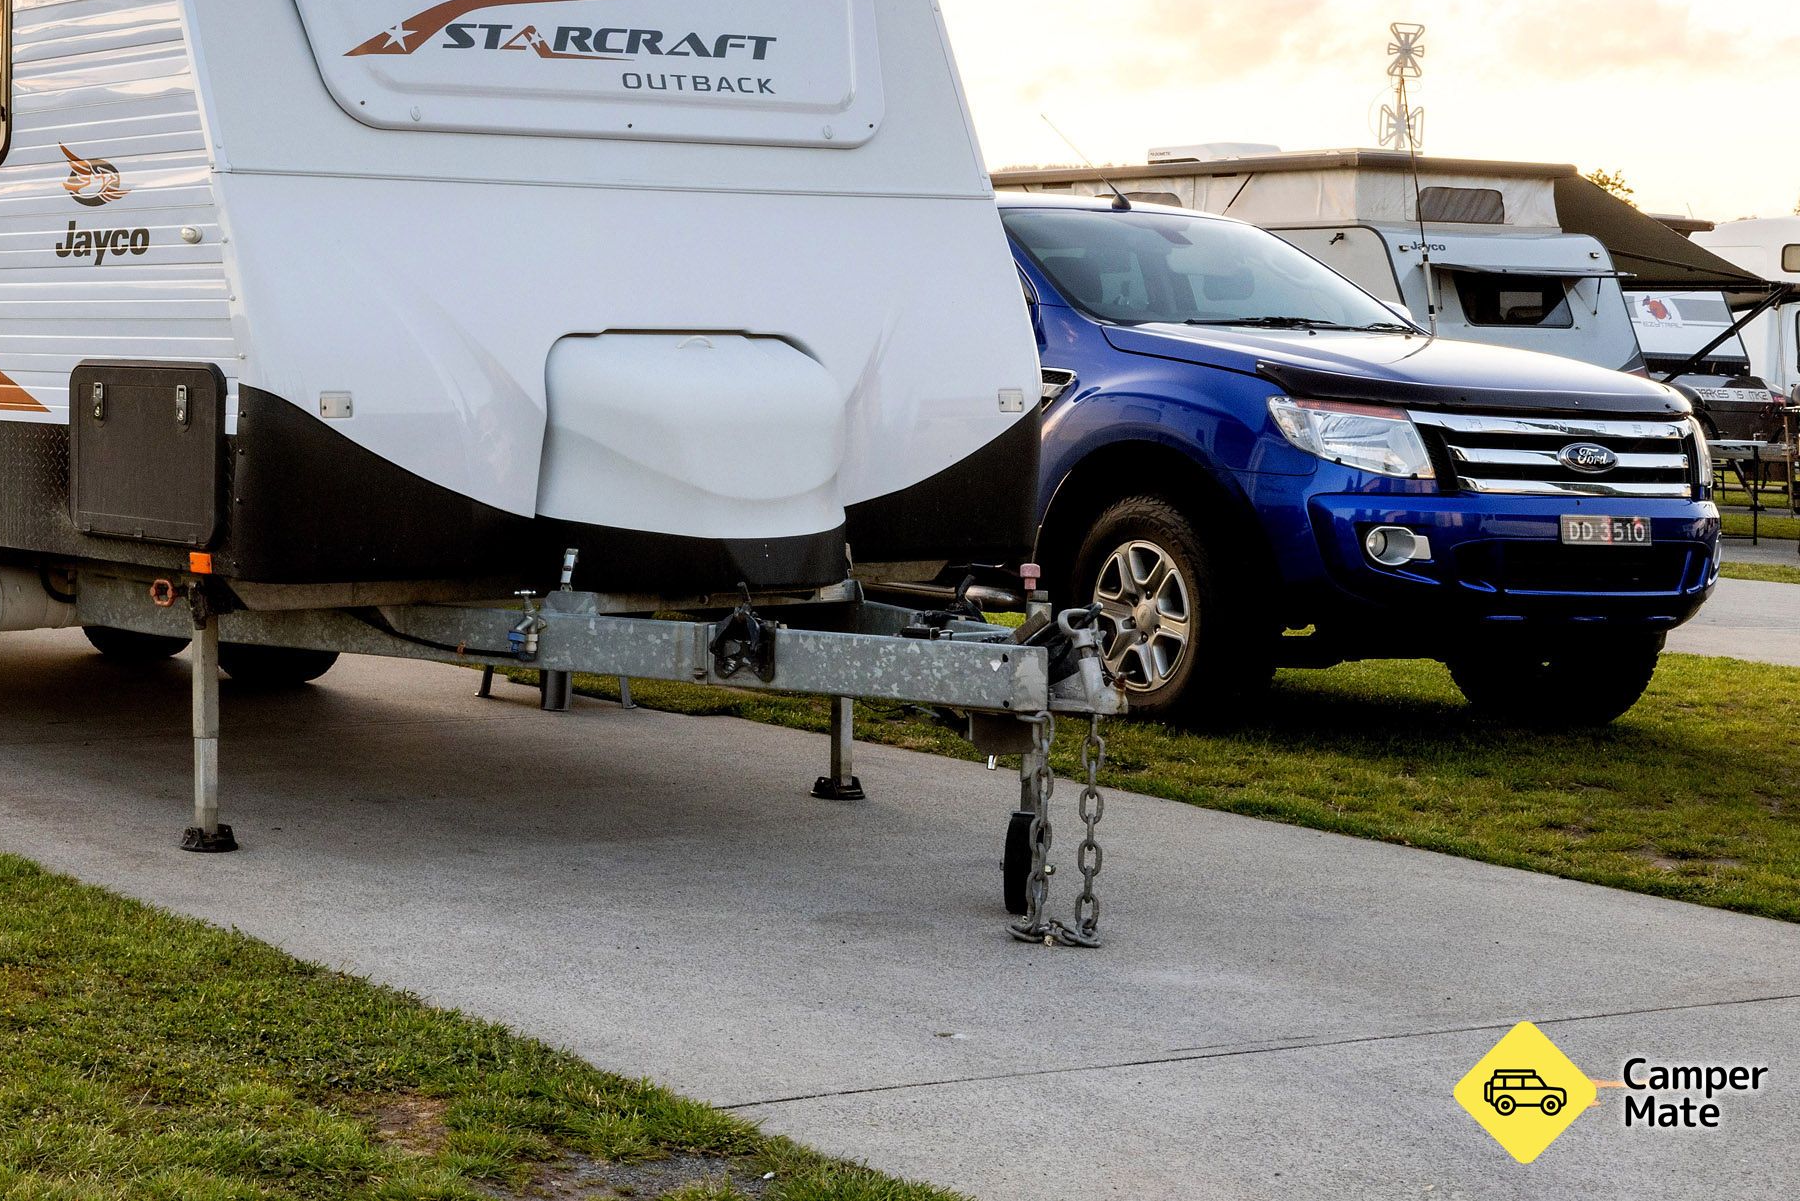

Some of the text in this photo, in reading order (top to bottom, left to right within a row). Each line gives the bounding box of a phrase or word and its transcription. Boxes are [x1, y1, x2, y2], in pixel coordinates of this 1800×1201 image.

[442, 23, 778, 62] STARCRAFT
[621, 72, 777, 95] OUTBACK
[55, 220, 150, 266] Jayco
[1577, 447, 1608, 465] Ford
